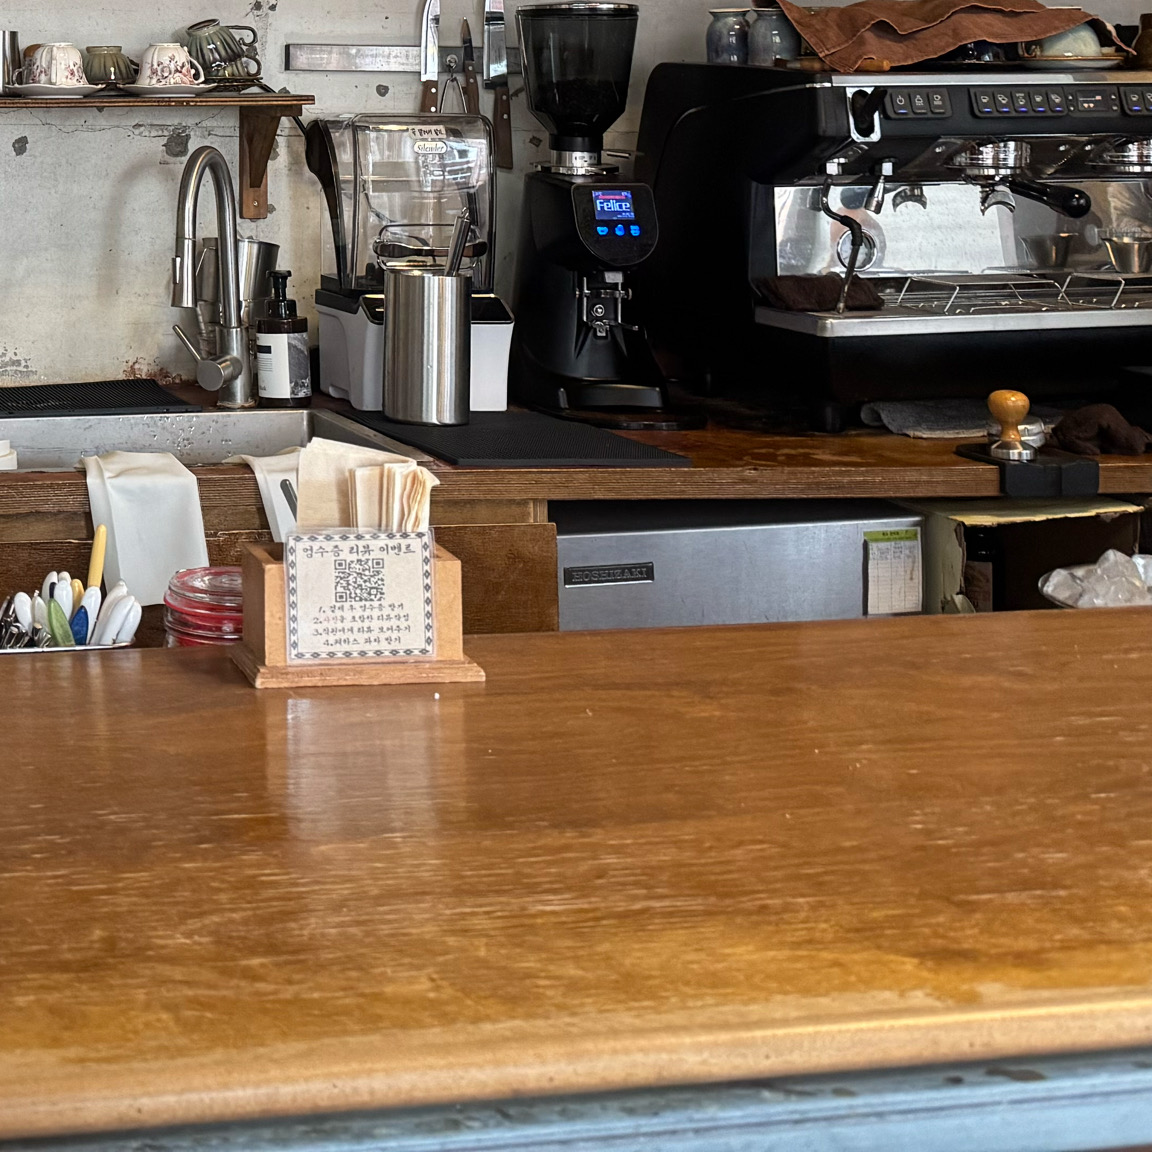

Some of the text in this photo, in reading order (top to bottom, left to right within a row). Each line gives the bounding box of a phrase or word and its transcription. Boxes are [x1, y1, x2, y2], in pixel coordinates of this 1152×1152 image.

[596, 200, 631, 212] Felice
[303, 545, 344, 558] 영수증
[349, 544, 374, 557] 리뷰
[572, 568, 647, 582] HOSHIZAKI
[318, 606, 326, 614] 1.
